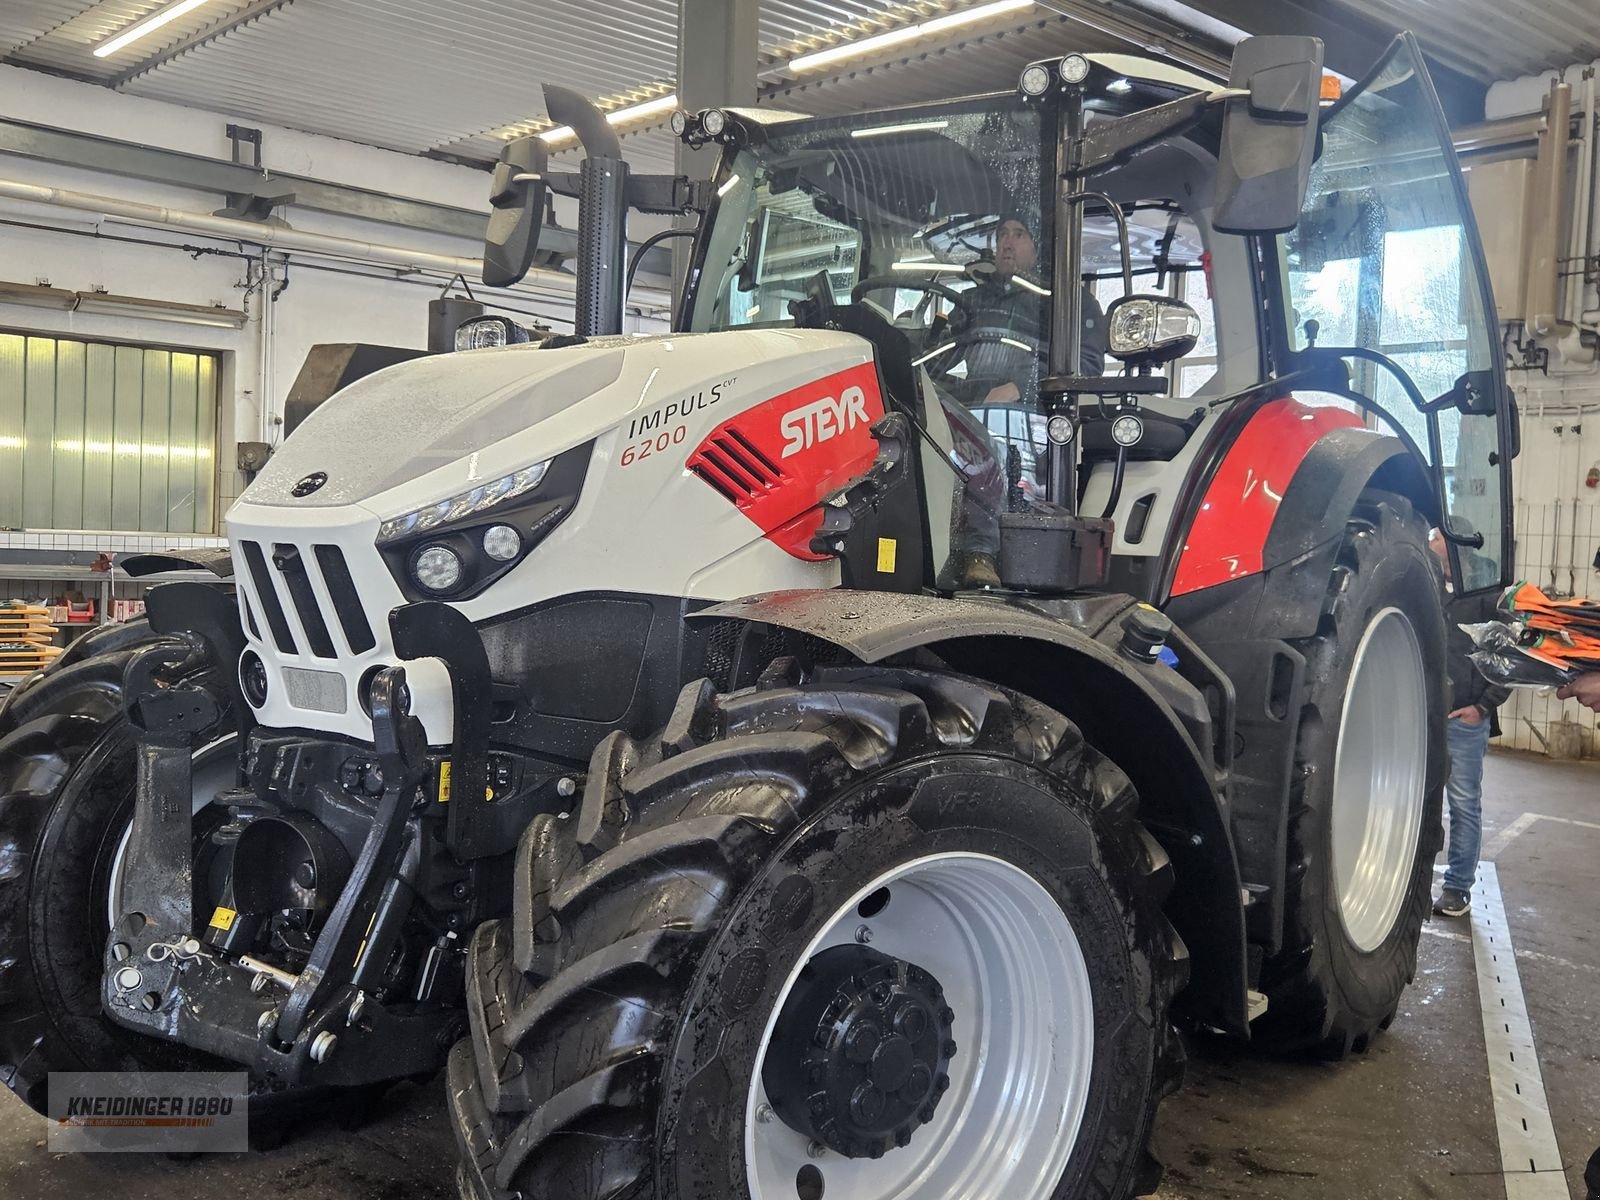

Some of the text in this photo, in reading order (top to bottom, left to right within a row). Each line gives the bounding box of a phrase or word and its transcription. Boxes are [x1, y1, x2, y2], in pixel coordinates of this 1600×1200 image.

[628, 377, 737, 439] IMPULS CVT
[781, 386, 870, 458] STEYR
[620, 425, 687, 467] 6200
